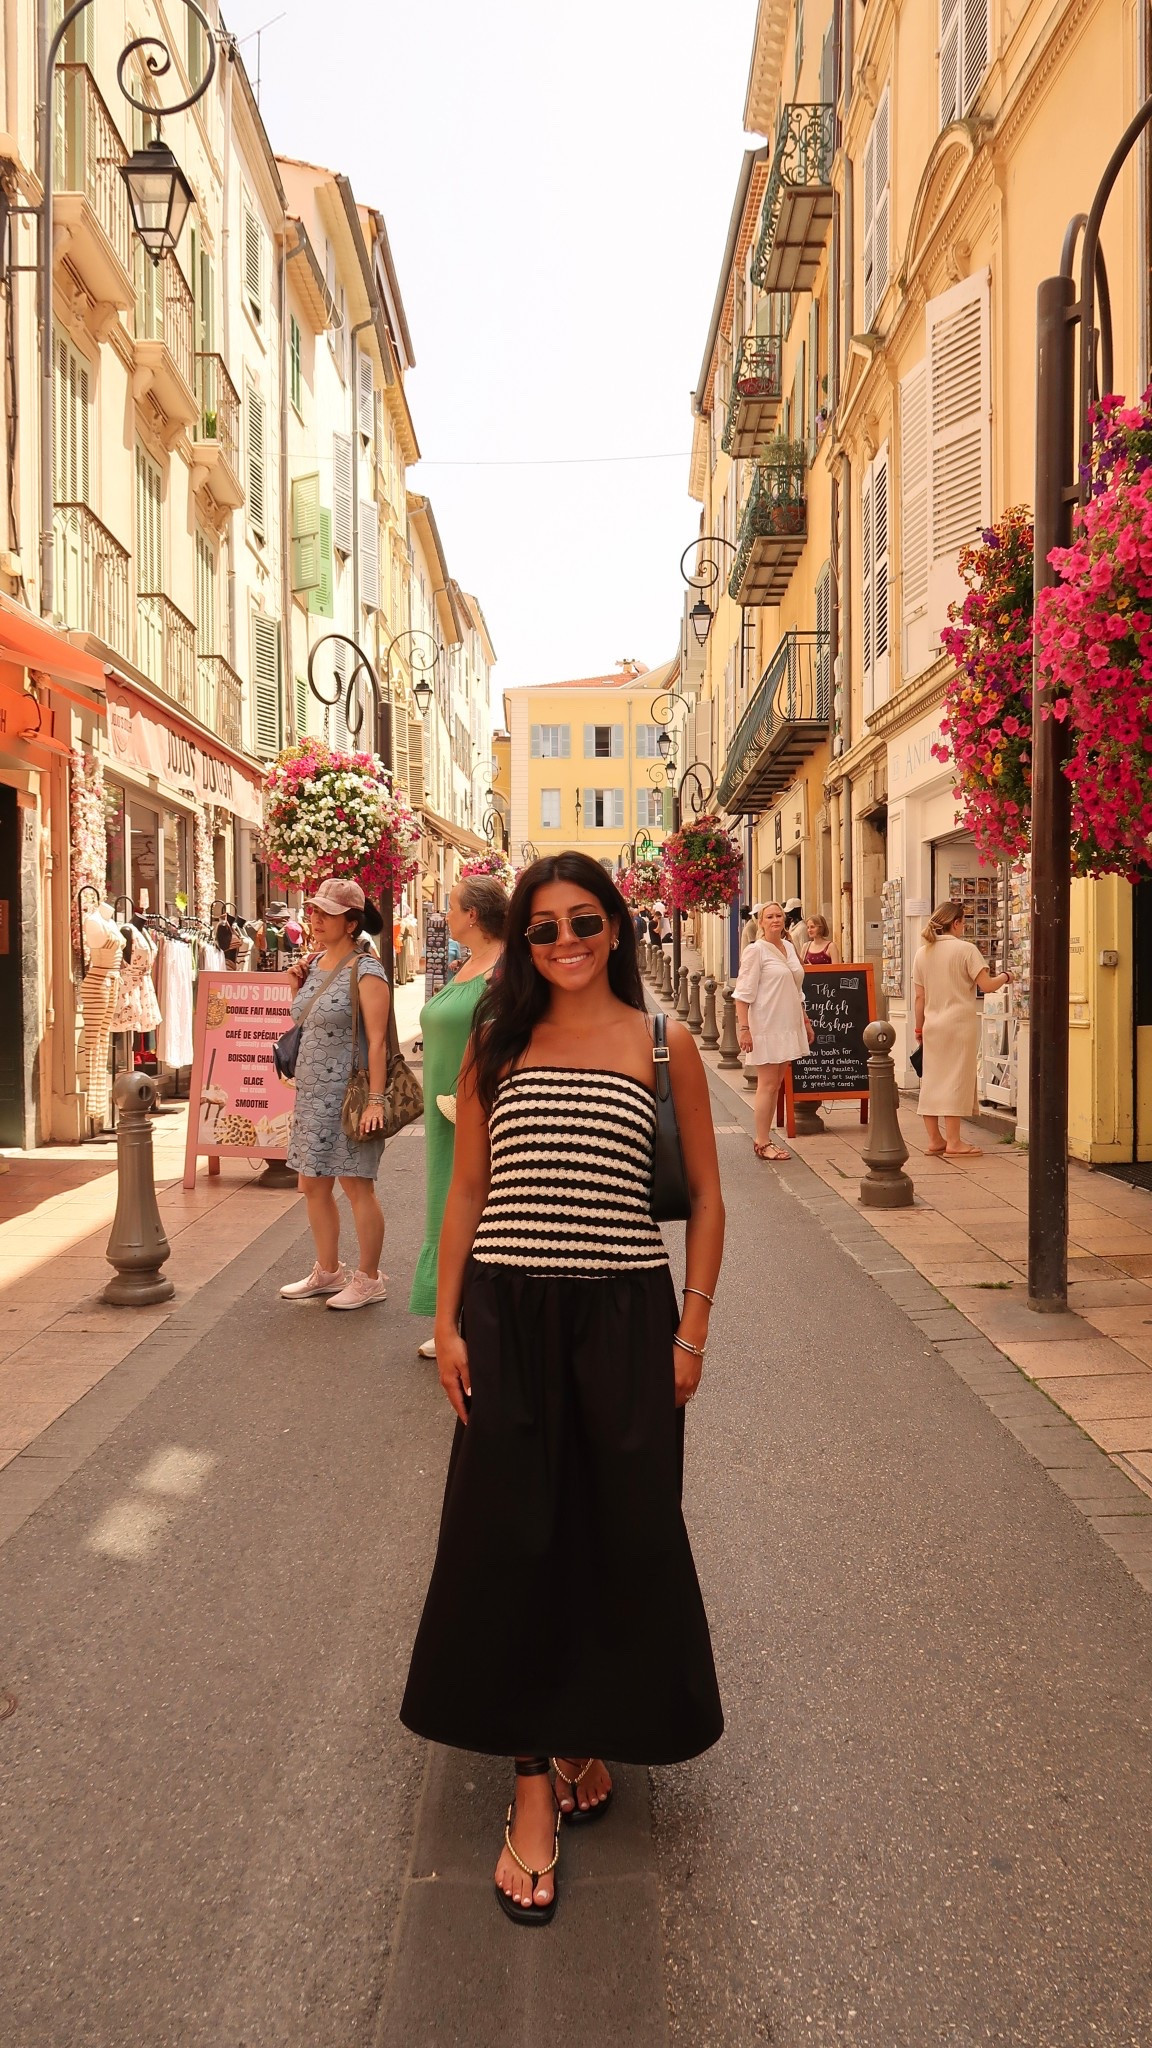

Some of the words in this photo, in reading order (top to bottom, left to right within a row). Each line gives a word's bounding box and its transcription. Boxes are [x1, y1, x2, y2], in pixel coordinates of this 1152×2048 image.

[218, 985, 259, 1001] JOJO'S
[811, 983, 836, 998] The
[226, 1006, 249, 1015] COOKIE
[250, 1006, 264, 1016] FAIT
[803, 999, 849, 1016] English
[225, 1029, 242, 1039] CAFÉ
[243, 1031, 251, 1040] DE
[820, 1048, 840, 1056] books
[842, 1047, 853, 1055] for
[227, 1053, 256, 1063] BOISSON
[257, 1054, 275, 1064] CHAU
[796, 1058, 818, 1066] adults
[803, 1066, 823, 1075] games
[243, 1077, 264, 1086] GLACE
[802, 1080, 808, 1089] &
[810, 1081, 836, 1089] greeting
[235, 1098, 269, 1109] SMOOTHIE
